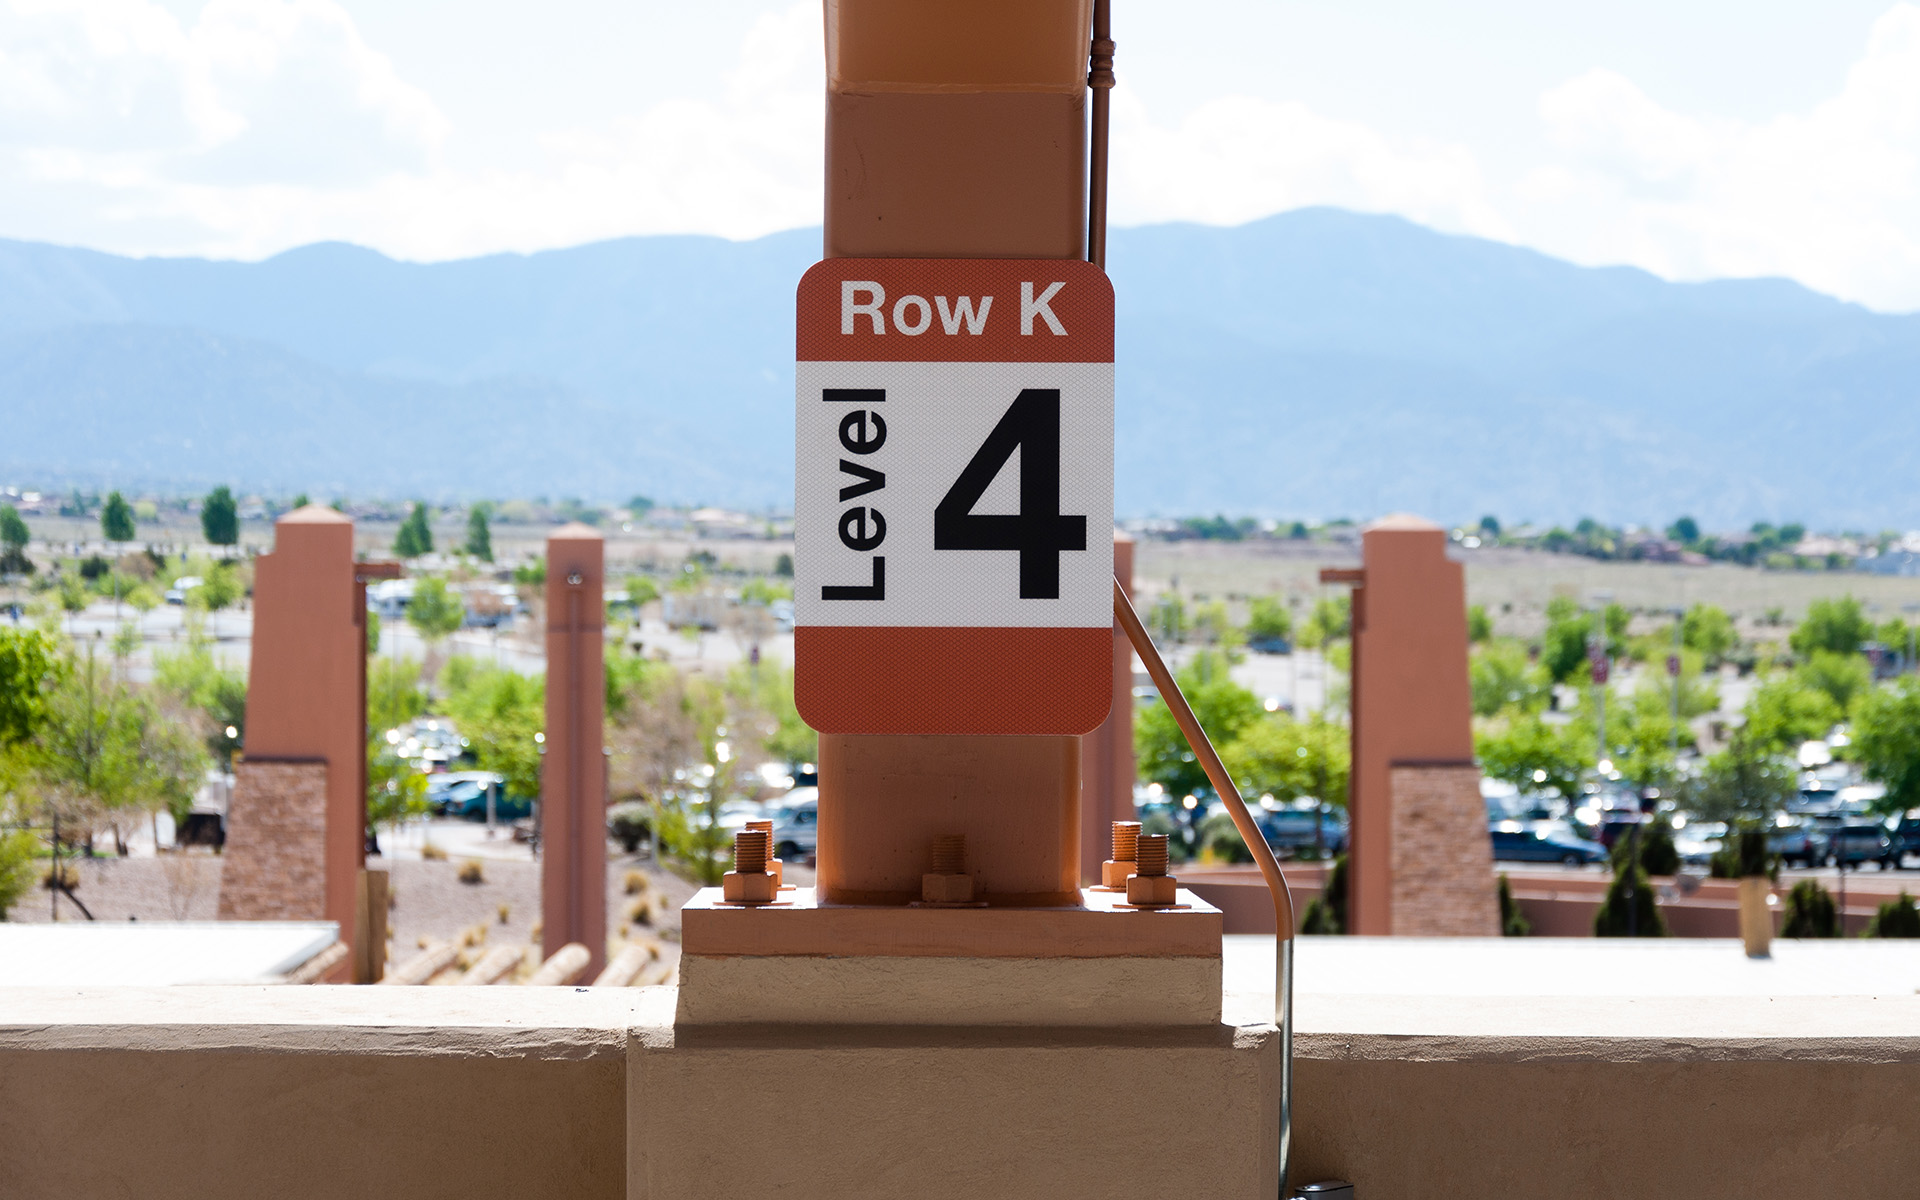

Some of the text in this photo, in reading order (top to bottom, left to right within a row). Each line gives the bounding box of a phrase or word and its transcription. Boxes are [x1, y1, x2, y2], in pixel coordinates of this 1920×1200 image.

[841, 280, 1069, 336] Row K
[821, 388, 1087, 602] Level 4
